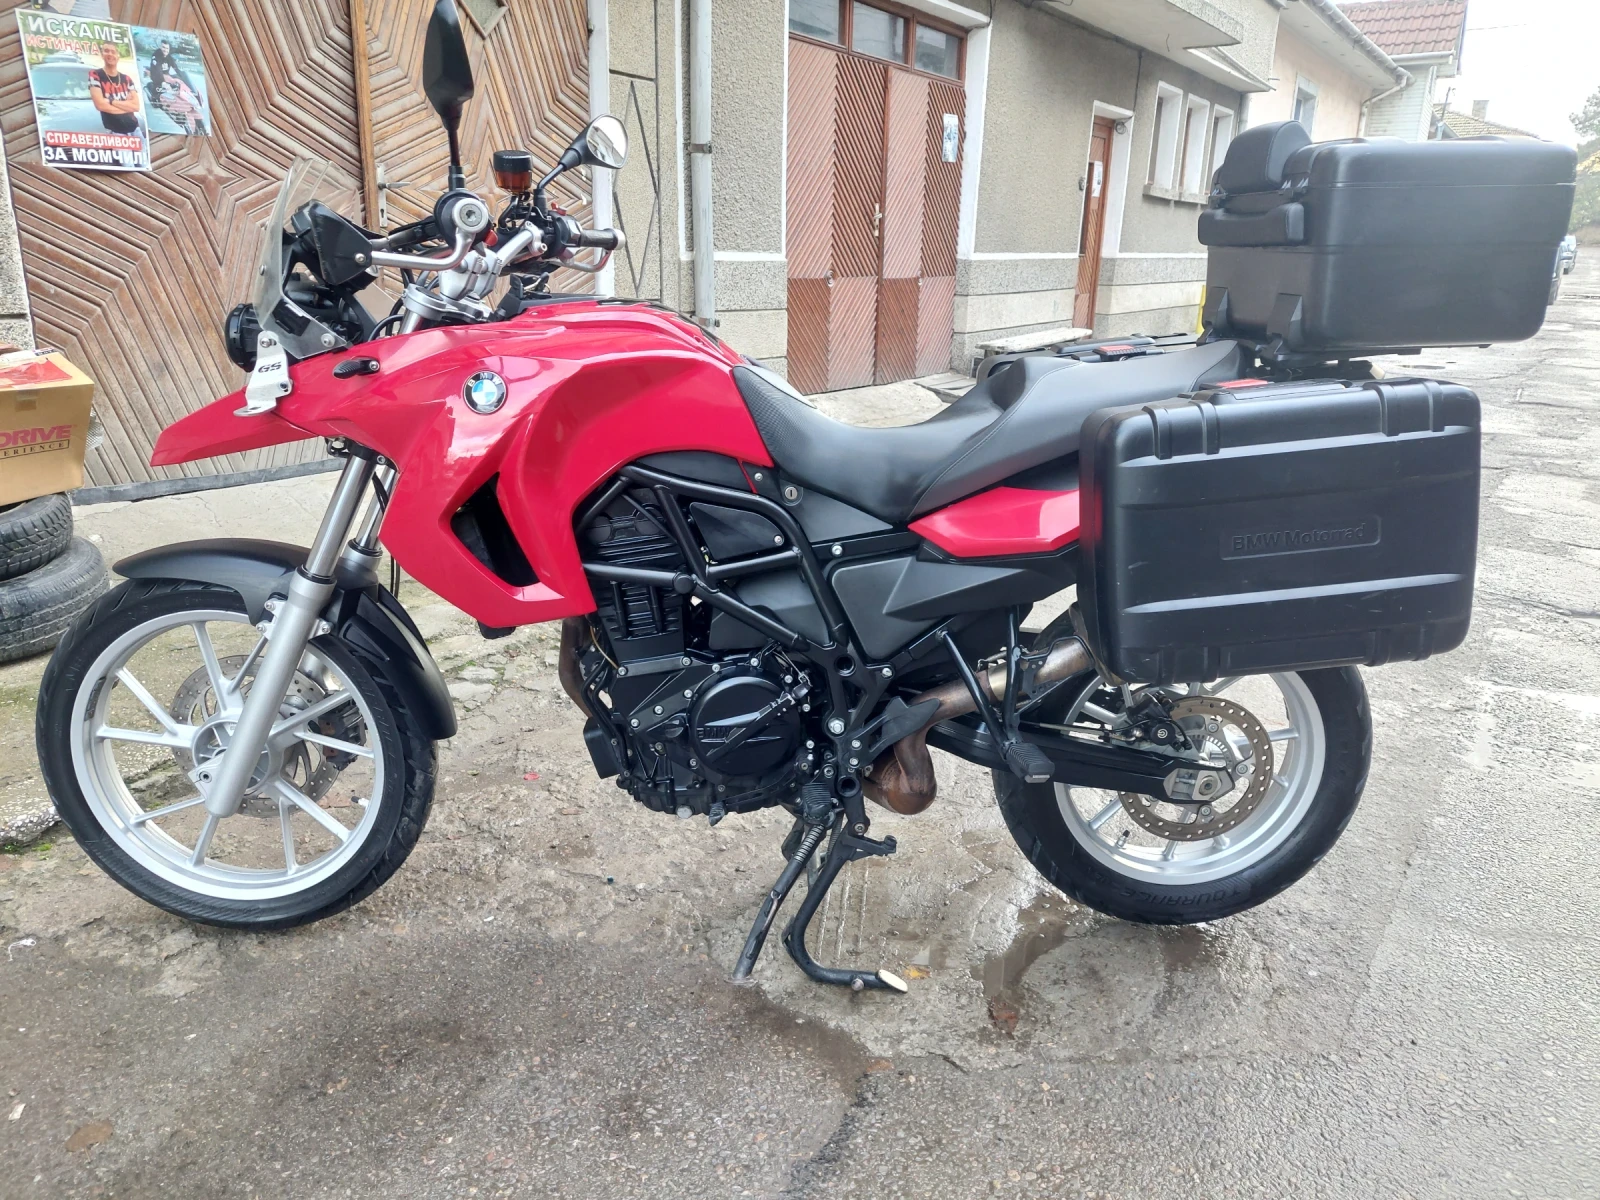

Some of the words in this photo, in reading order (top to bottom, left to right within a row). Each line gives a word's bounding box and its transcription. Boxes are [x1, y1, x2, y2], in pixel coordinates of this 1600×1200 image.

[46, 131, 141, 149] СПРАВЕДЛИВОСТ
[44, 147, 68, 161] ЗА
[257, 361, 282, 373] GS
[467, 372, 503, 387] BMW
[1232, 532, 1282, 551] BMW
[1284, 522, 1366, 545] Motorrad
